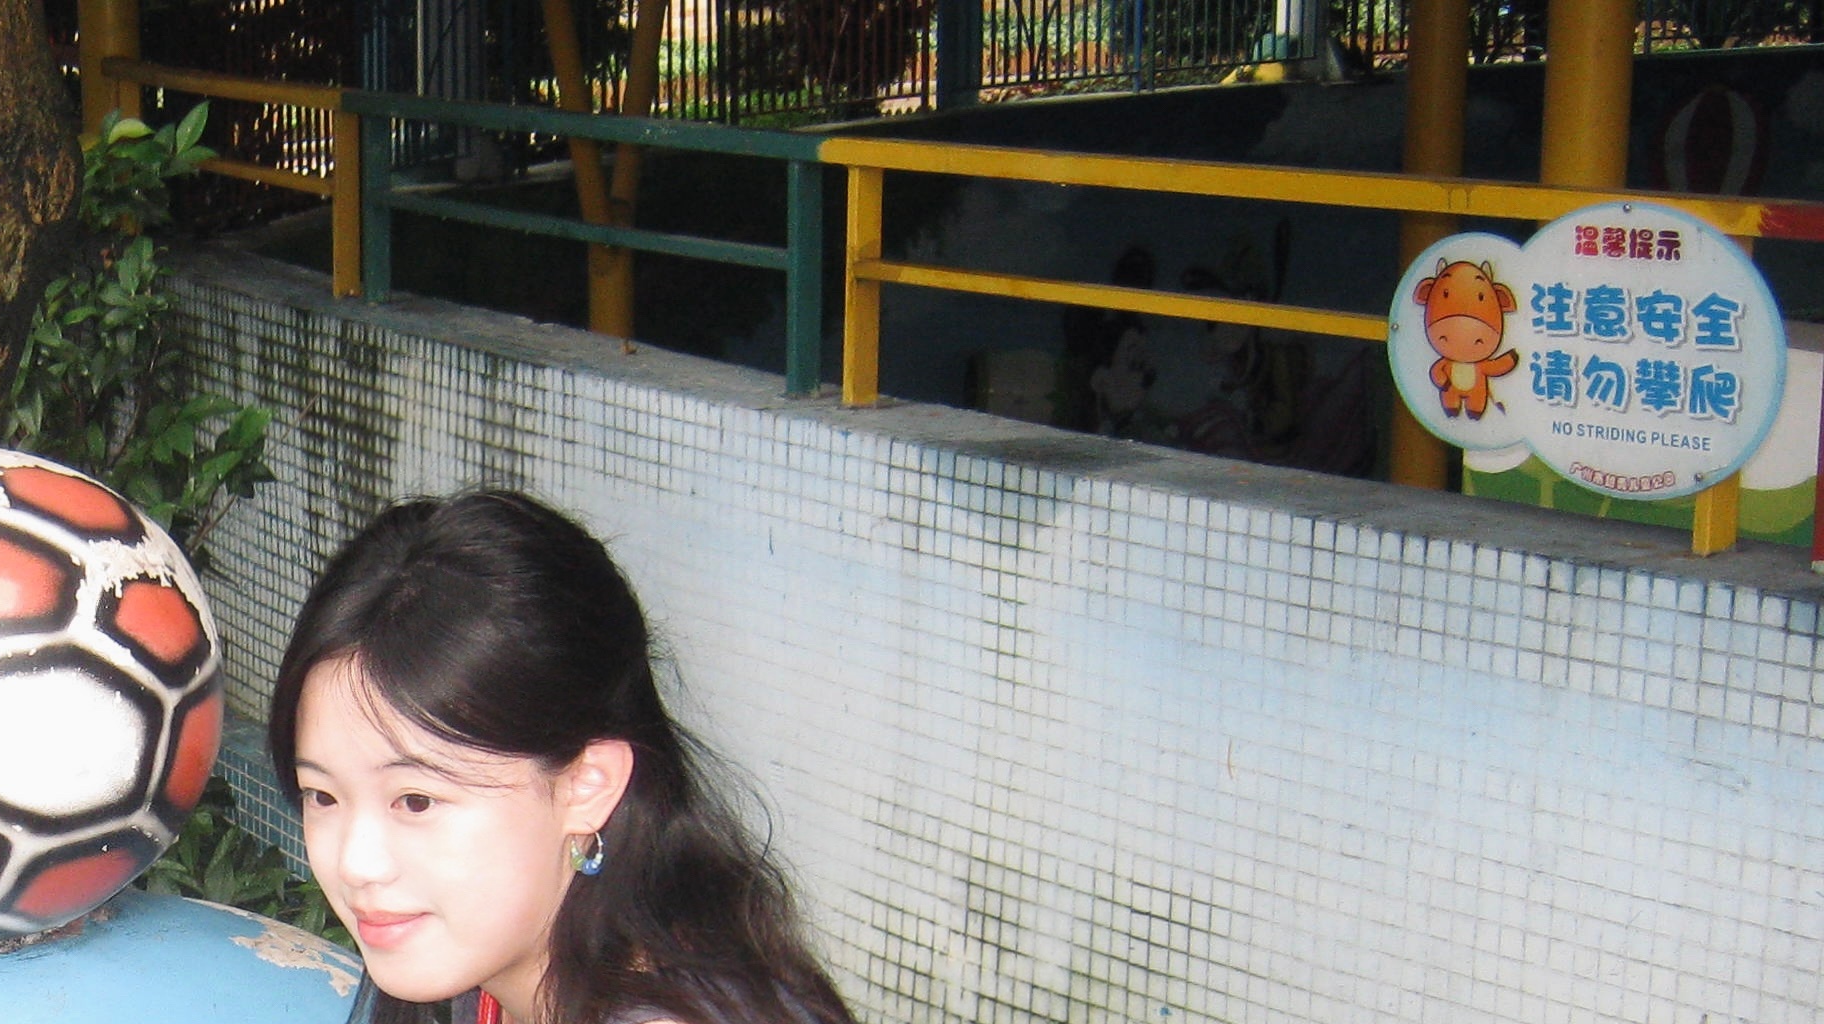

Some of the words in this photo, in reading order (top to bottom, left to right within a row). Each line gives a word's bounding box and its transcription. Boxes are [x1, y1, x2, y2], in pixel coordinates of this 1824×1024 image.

[1574, 226, 1681, 261] 温馨提示
[1530, 282, 1741, 348] 注意安全
[1529, 350, 1737, 420] 请勿攀爬
[1552, 421, 1573, 436] NO
[1576, 423, 1647, 444] STRIDING
[1651, 431, 1711, 451] PLEASE
